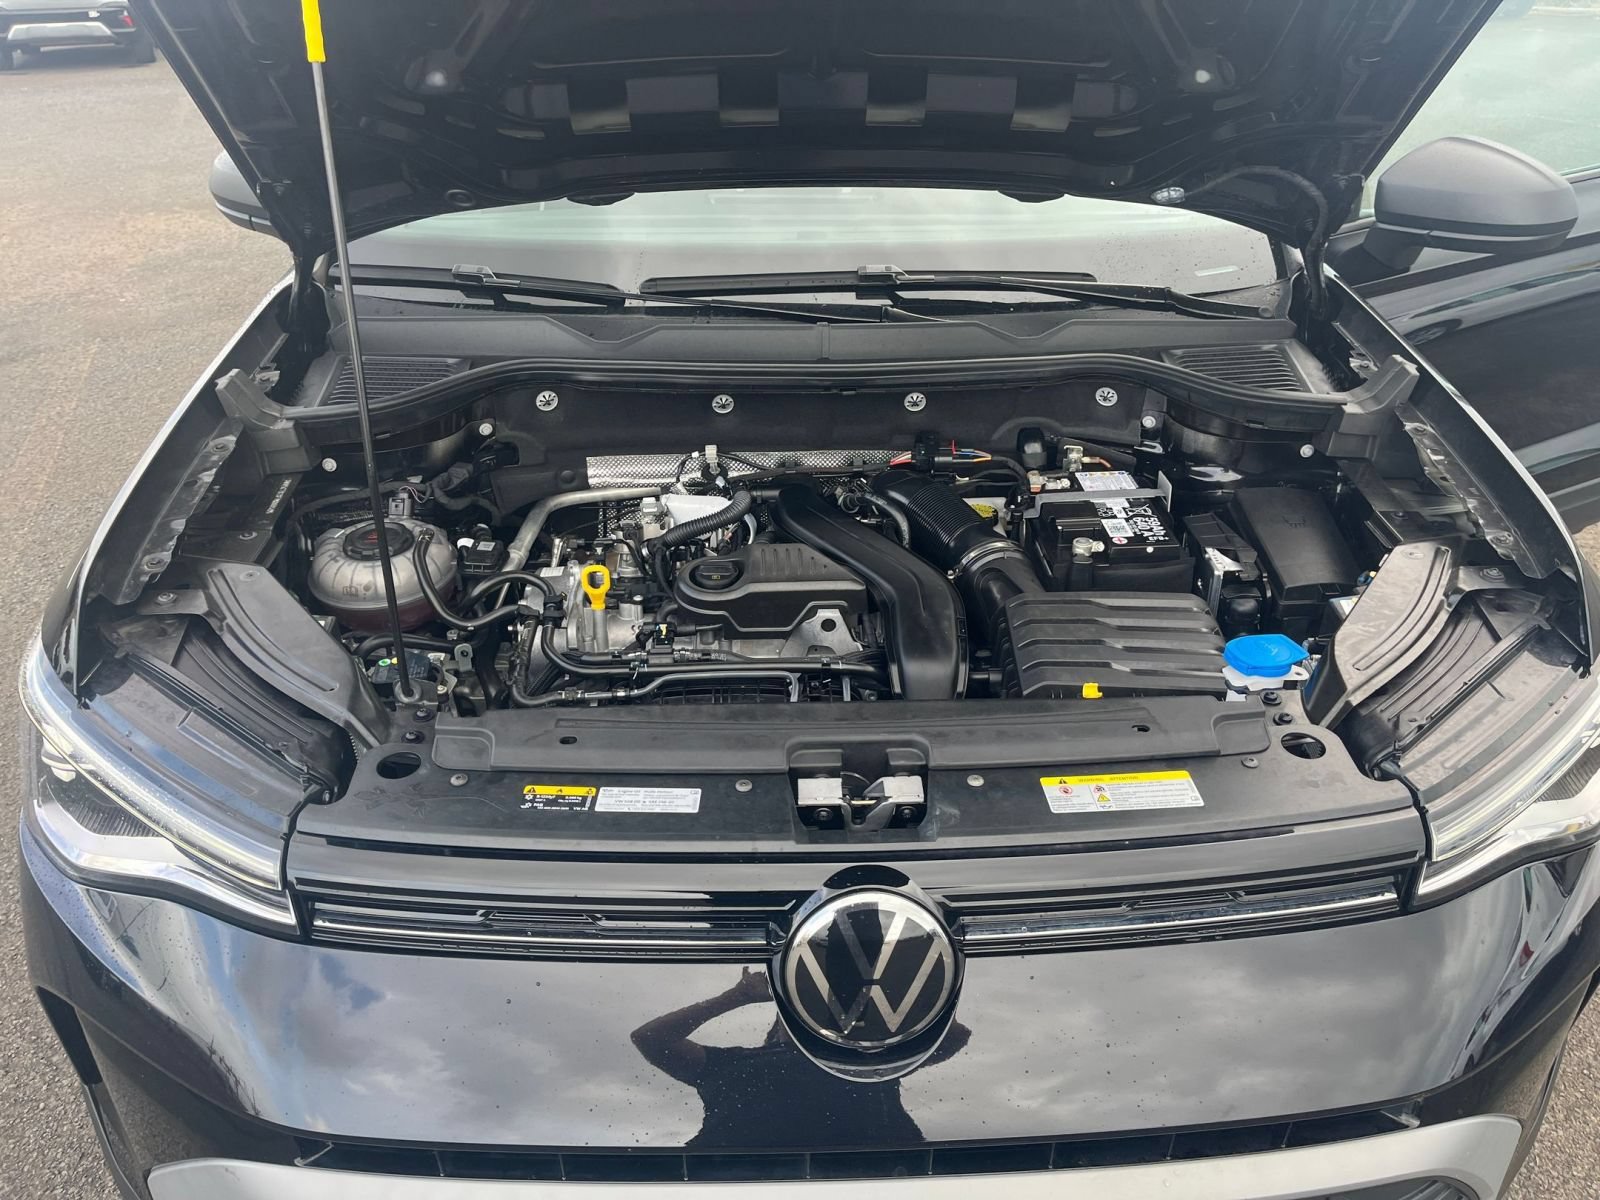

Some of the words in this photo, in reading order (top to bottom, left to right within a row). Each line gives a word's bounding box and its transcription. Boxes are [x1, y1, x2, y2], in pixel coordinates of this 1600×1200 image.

[1133, 517, 1150, 530] 640
[1145, 517, 1167, 536] 59Ah
[787, 895, 954, 1043] VW
